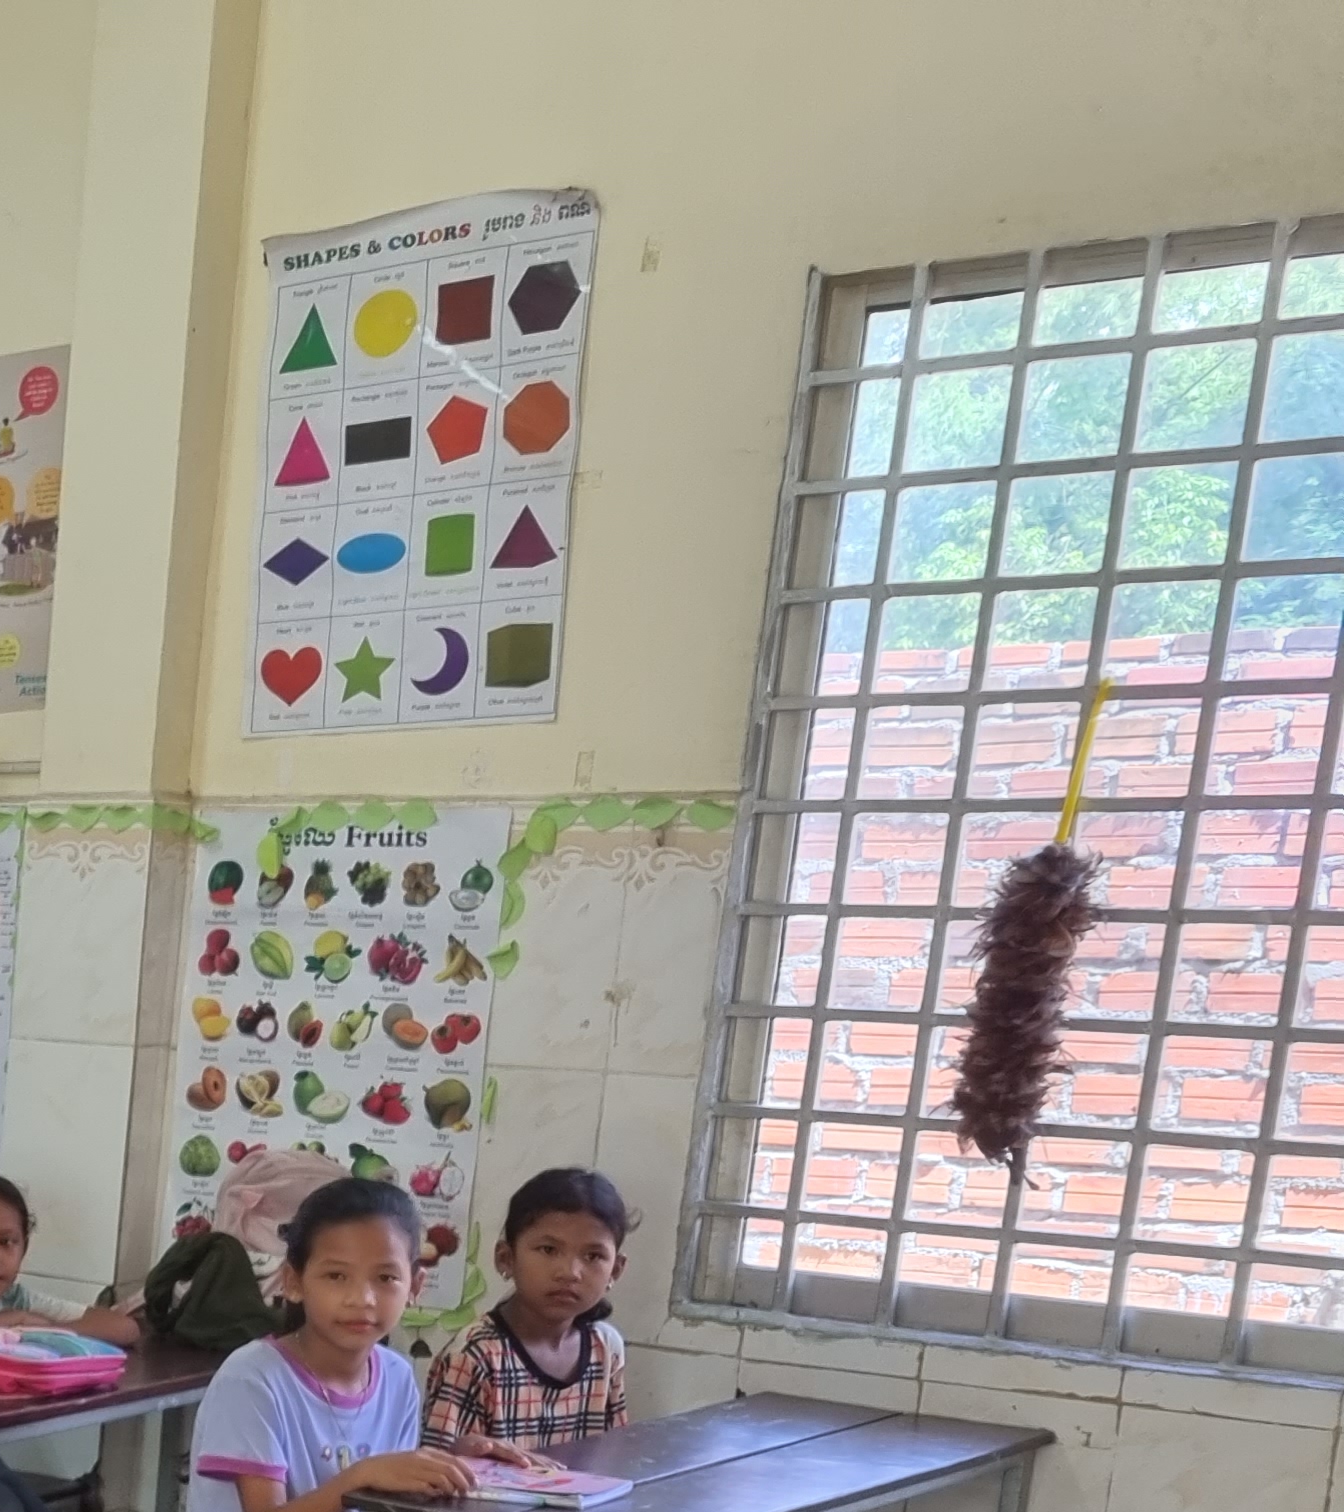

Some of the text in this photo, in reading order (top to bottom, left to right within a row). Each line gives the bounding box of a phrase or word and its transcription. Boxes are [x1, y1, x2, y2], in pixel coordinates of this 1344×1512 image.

[284, 223, 471, 272] SHAPES & COLORS
[345, 824, 428, 848] Fruits
